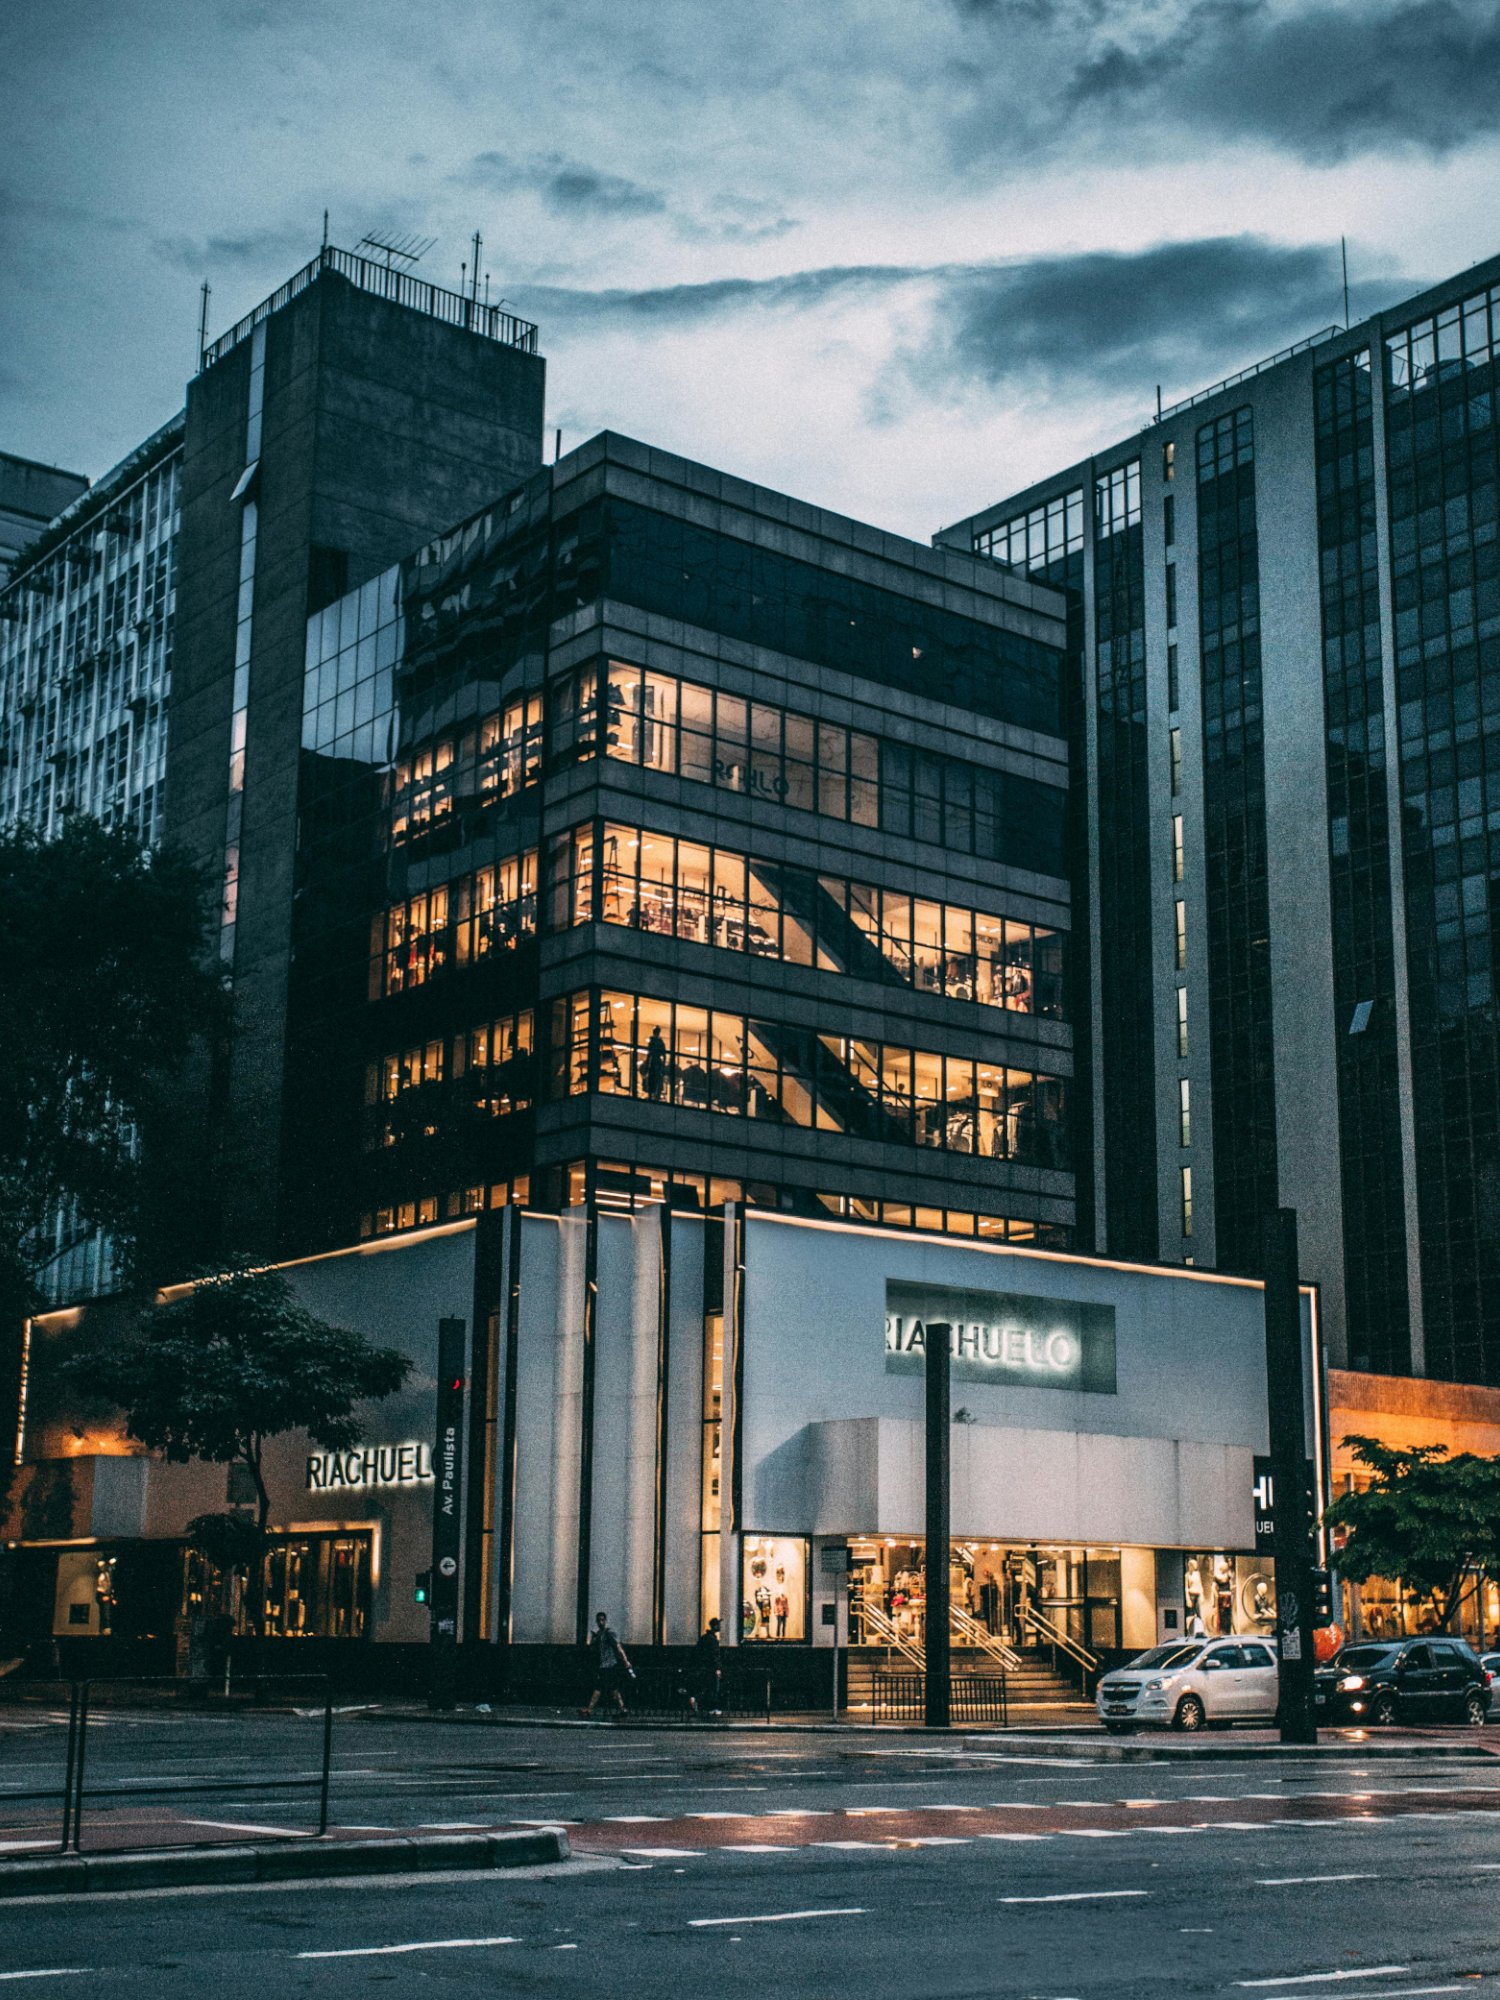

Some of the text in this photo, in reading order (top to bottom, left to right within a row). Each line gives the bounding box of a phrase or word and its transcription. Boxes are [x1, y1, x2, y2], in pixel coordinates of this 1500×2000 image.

[306, 1445, 436, 1488] RIACHUEL
[442, 1427, 456, 1515] Av. Paulista
